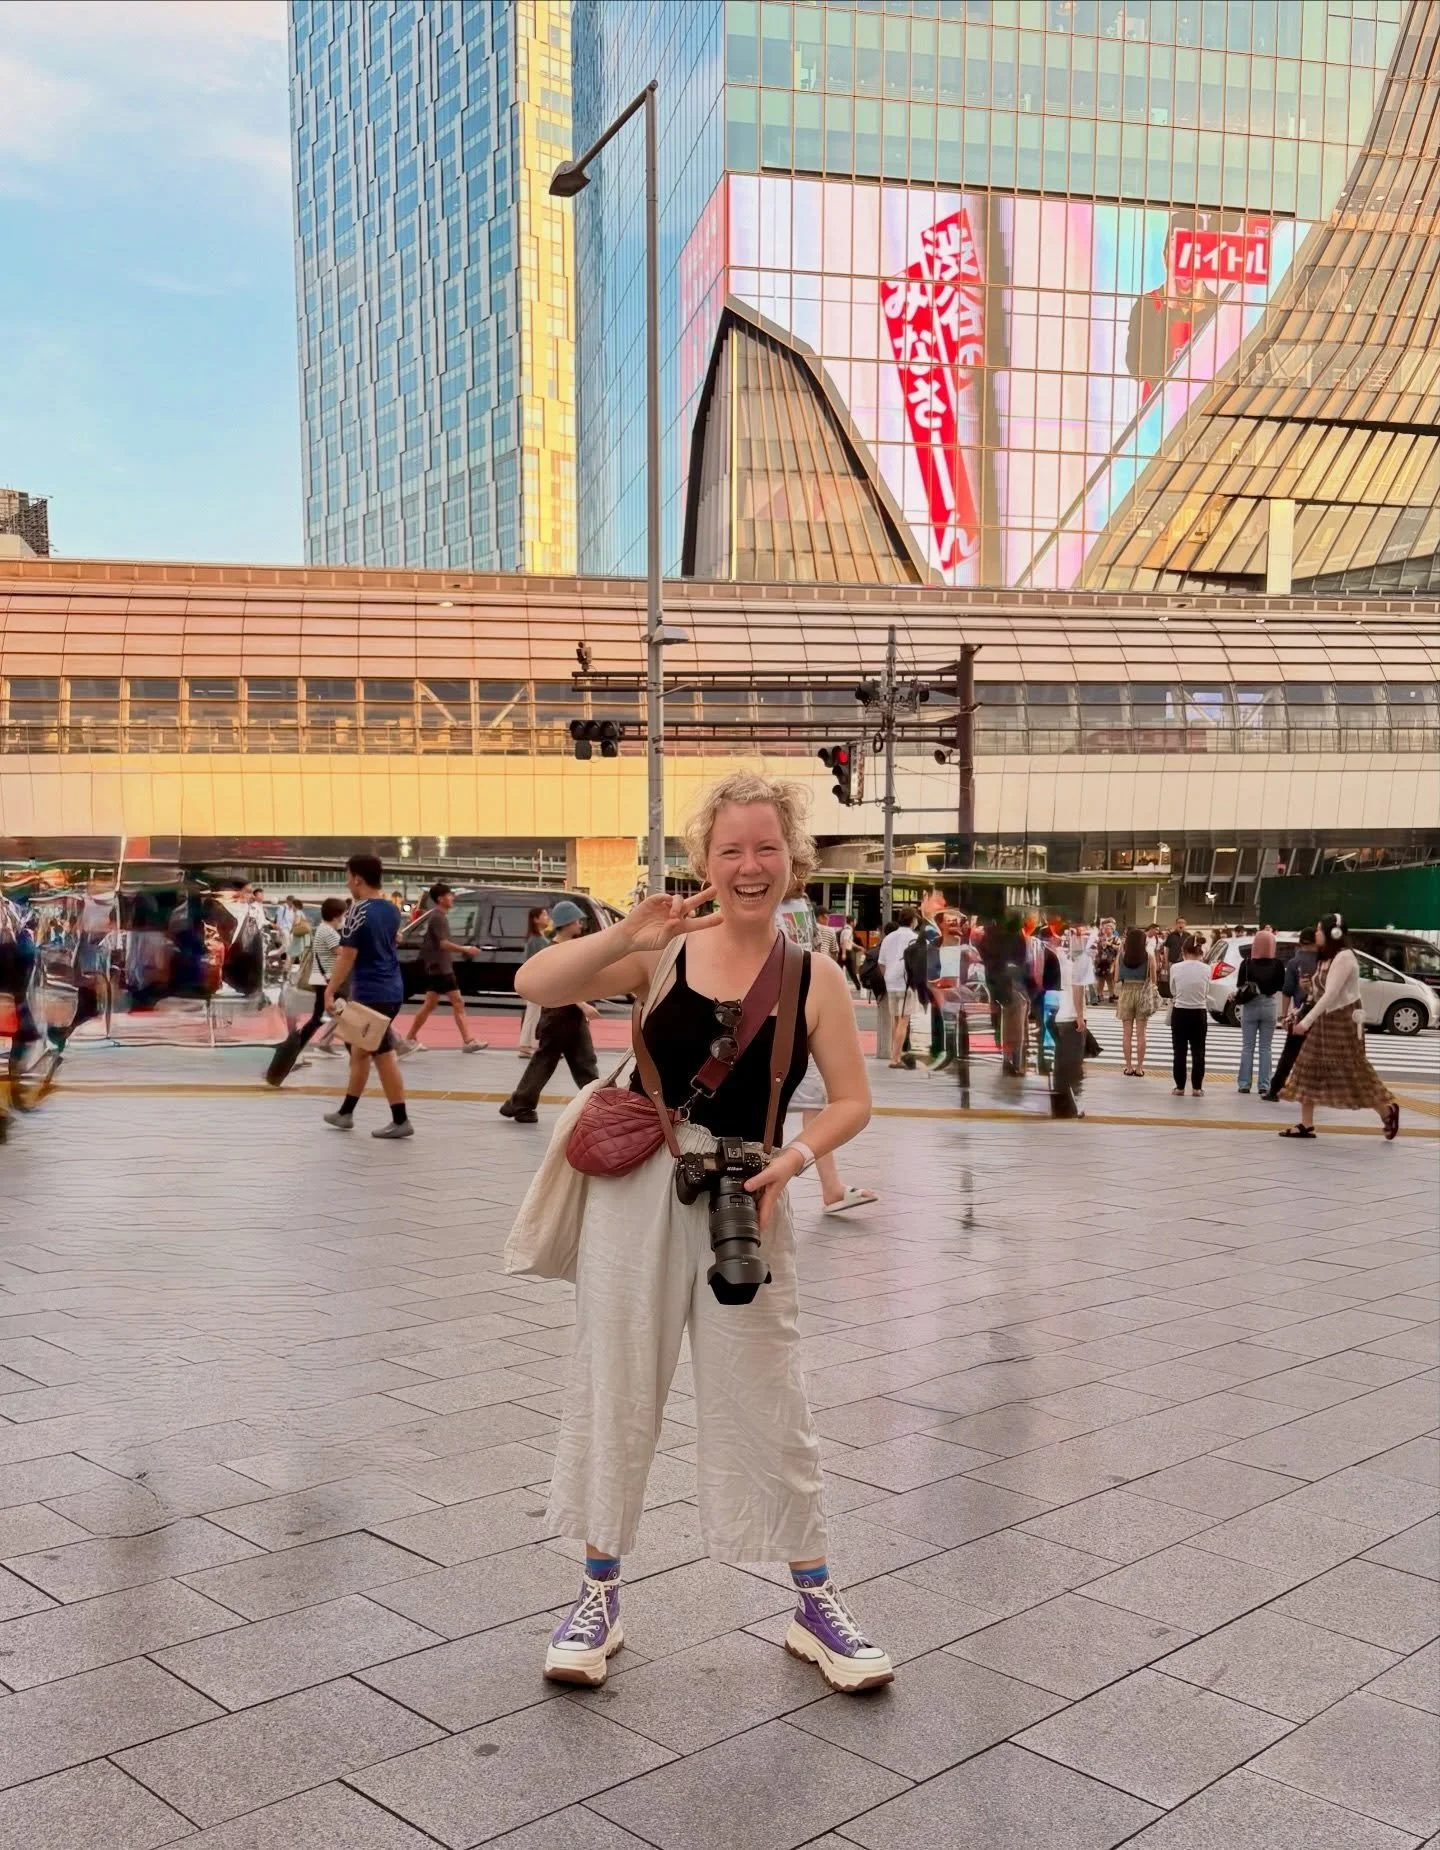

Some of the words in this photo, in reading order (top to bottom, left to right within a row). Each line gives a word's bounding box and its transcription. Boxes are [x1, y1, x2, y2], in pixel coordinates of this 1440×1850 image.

[923, 223, 985, 379] 渋谷の
[1178, 240, 1267, 274] バイトル
[885, 272, 980, 562] みなさーん
